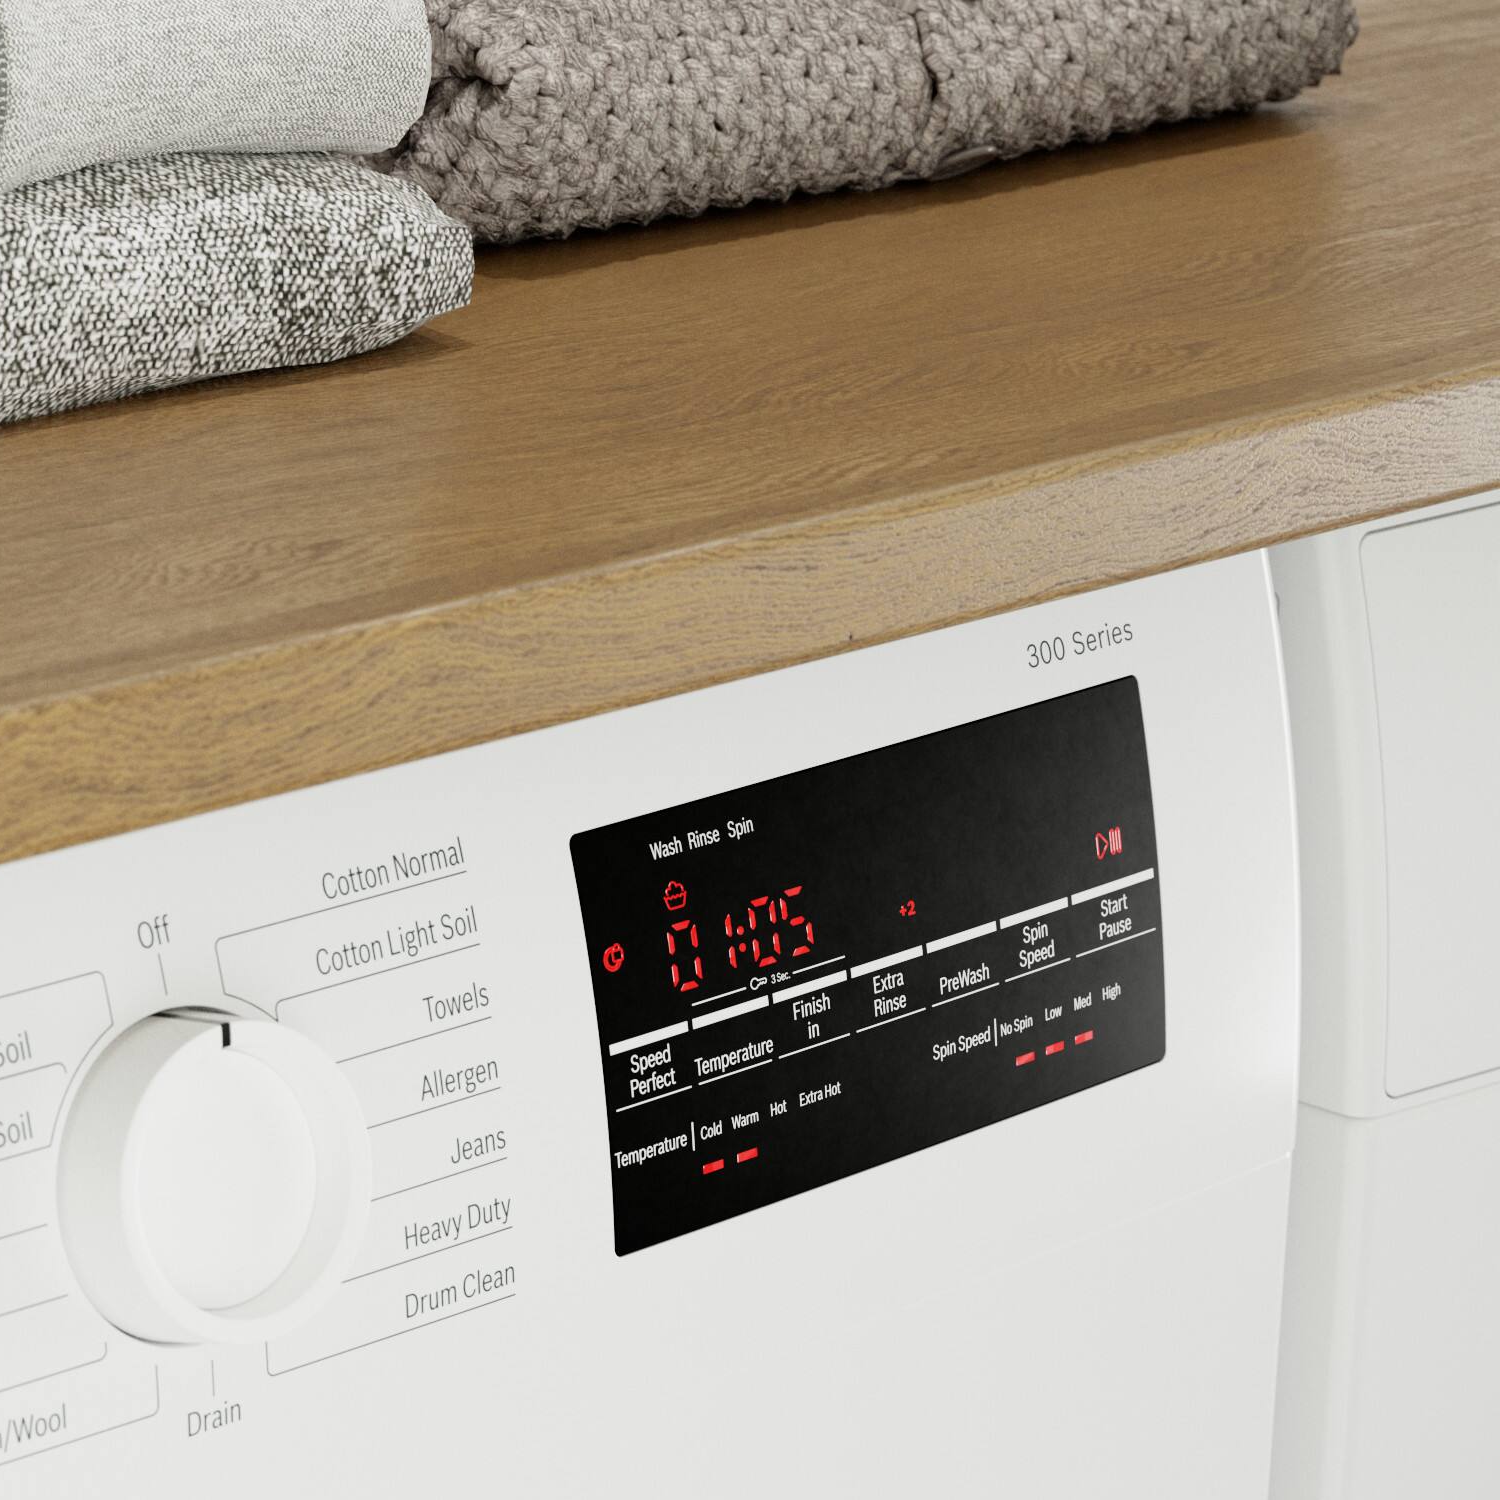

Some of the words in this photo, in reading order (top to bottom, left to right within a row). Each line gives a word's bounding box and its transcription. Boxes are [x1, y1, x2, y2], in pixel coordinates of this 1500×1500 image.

[1026, 636, 1066, 669] 300
[1072, 619, 1134, 657] Series
[649, 836, 683, 860] Wash
[687, 827, 721, 850] Rinse
[727, 817, 754, 840] Spin
[322, 861, 389, 900] Cotton
[393, 836, 465, 881] Normal
[899, 900, 916, 917] +2
[1100, 893, 1128, 918] Start
[137, 914, 170, 950] Off
[316, 936, 383, 976] Cotton
[387, 919, 438, 959] Light
[442, 906, 478, 940] Soil
[666, 885, 814, 993] 01:05
[1022, 921, 1049, 946] Spin
[1099, 917, 1132, 940] Pause
[1019, 940, 1055, 969] Speed
[872, 972, 904, 995] Extra
[939, 963, 990, 995] PreWash
[423, 983, 490, 1023] Towels
[792, 992, 831, 1021] Finish
[873, 992, 907, 1019] Rinse
[932, 1041, 957, 1061] Spin
[958, 1026, 990, 1053] Speed
[1000, 1022, 1012, 1037] No
[1013, 1015, 1033, 1034] Spin
[1044, 1005, 1062, 1021] Low
[1073, 992, 1092, 1011] Med
[1102, 983, 1121, 1001] High
[808, 1021, 820, 1040] in
[630, 1043, 672, 1076] Speed
[694, 1038, 774, 1077] Temperature
[421, 1058, 499, 1102] Allergen
[629, 1067, 677, 1098] Perfect
[614, 1133, 688, 1169] Temperature
[700, 1120, 723, 1141] Cold
[731, 1110, 759, 1130] Warm
[770, 1099, 787, 1117] Hot
[799, 1089, 823, 1107] Extra
[824, 1081, 841, 1099] Hot
[451, 1127, 507, 1165] Jeans
[404, 1212, 462, 1250] Heavy
[467, 1194, 512, 1233] Duty
[405, 1283, 457, 1319] Drum
[463, 1262, 516, 1299] Clean
[186, 1400, 241, 1438] Drain
